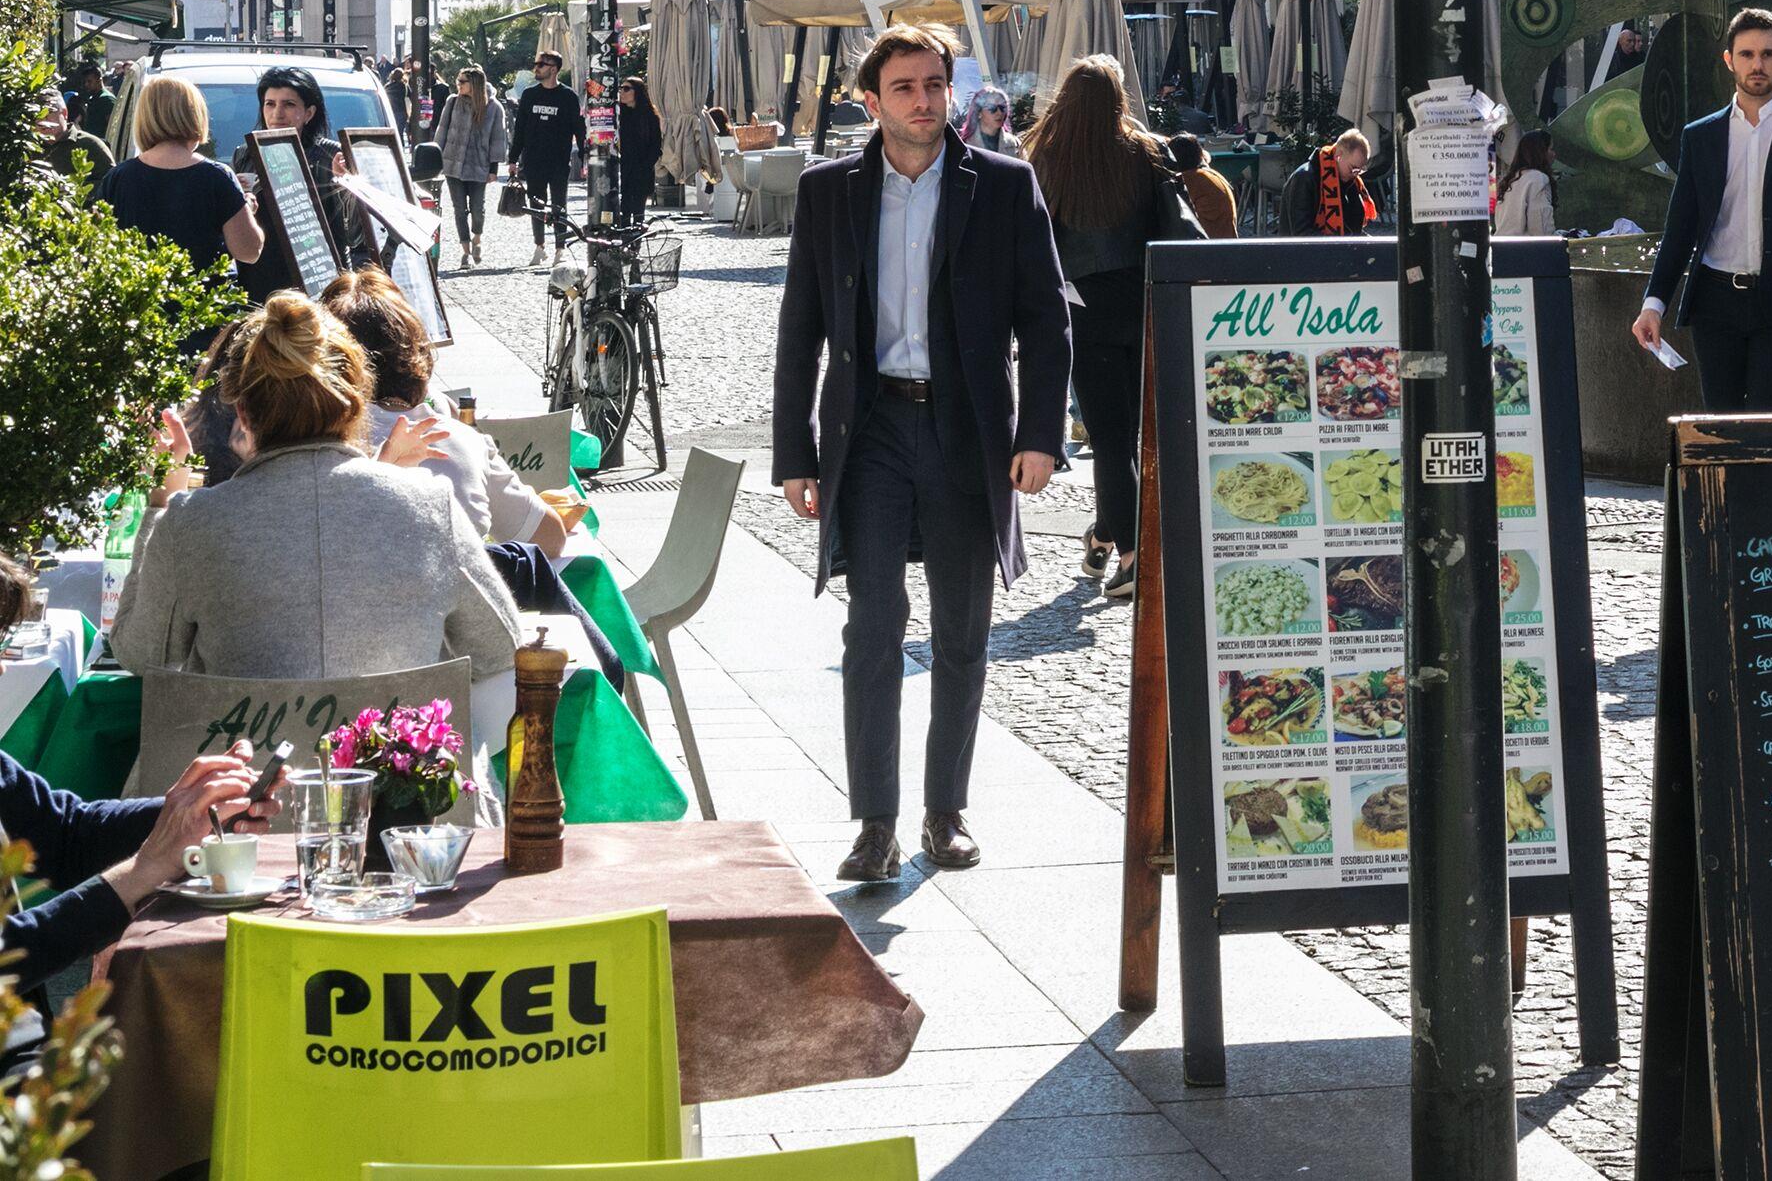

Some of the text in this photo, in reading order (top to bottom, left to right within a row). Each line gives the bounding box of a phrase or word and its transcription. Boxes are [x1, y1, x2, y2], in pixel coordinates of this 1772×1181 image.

[1208, 428, 1237, 438] INSALATA
[1245, 427, 1263, 437] MARE
[1263, 426, 1284, 436] CALDA
[1319, 425, 1335, 434] PIZZA
[1344, 424, 1365, 434] FRUTTI
[1373, 423, 1390, 433] MARE
[1430, 440, 1479, 458] UTAH
[1426, 458, 1485, 475] ETHER
[1212, 530, 1299, 542] SPAGHETTI ALLA CARBONARA
[1360, 527, 1378, 536] MAGRO
[1378, 526, 1388, 536] CON
[1503, 626, 1544, 637] ALLA MILANESE
[1217, 637, 1323, 651] GNOCCHI VERDI CON SALMONE ASPARAGI
[1329, 634, 1380, 646] FIORENTINA ALLA
[1529, 736, 1549, 747] VERDURE
[1222, 747, 1328, 761] FILETTINO SPIGOLA CON OLIVE
[1335, 744, 1386, 756] MISTO PESCE ALLA
[1227, 858, 1334, 871] TARTARE MANZO CROSTINI PANE
[1340, 854, 1390, 866] OSSOBUCO ALLA
[303, 960, 607, 1043] PIXEL
[304, 1031, 607, 1073] CORSOCOMODODICI
